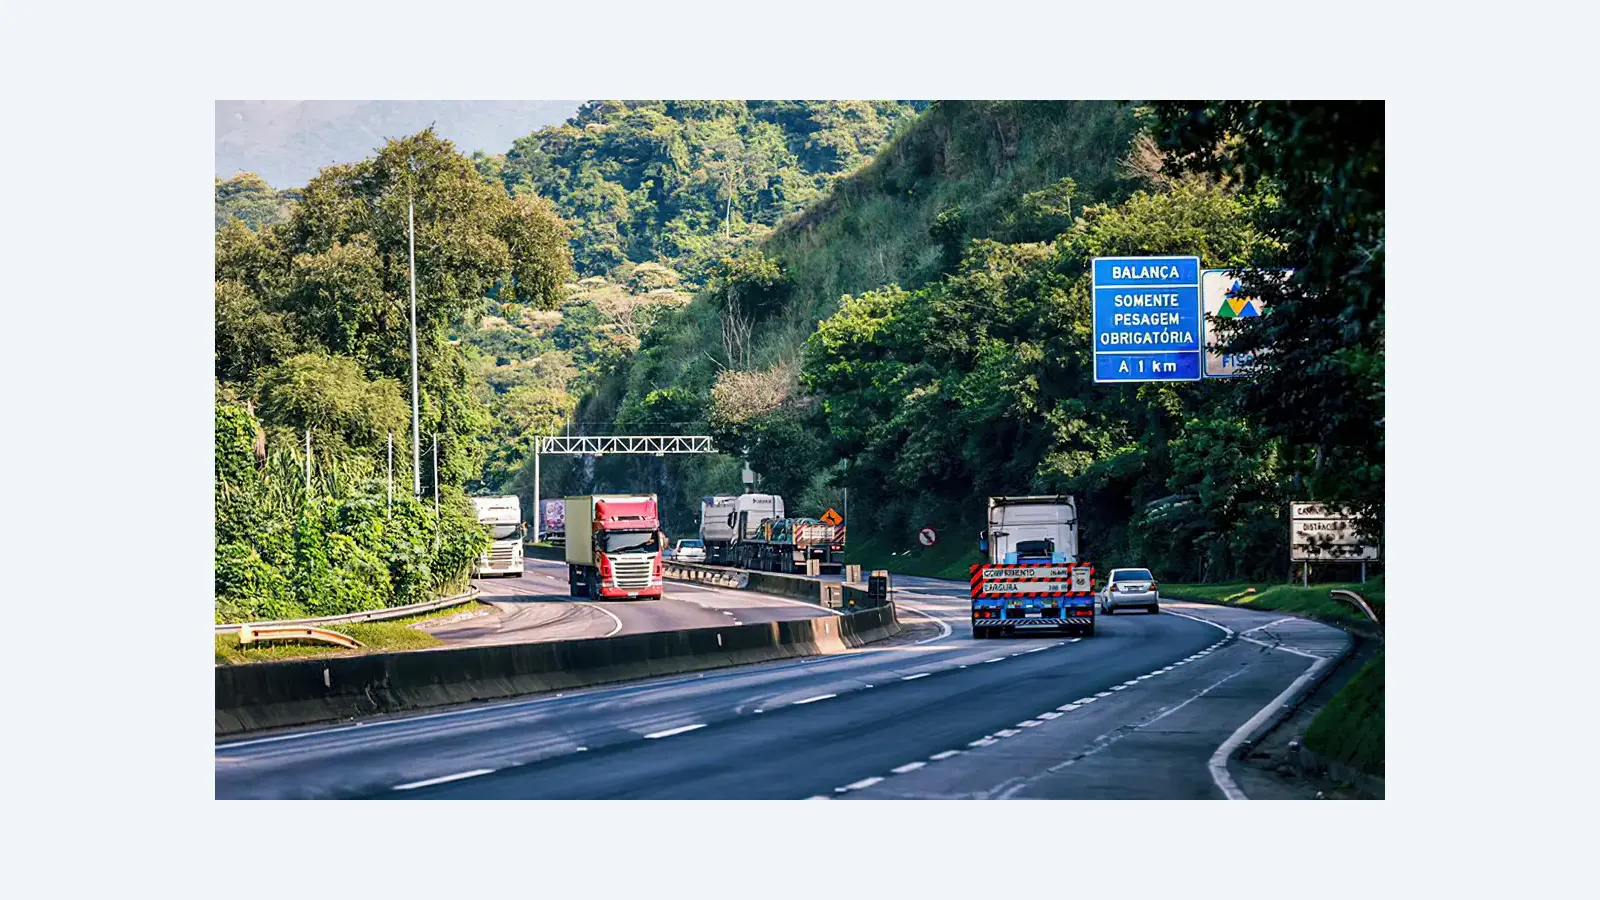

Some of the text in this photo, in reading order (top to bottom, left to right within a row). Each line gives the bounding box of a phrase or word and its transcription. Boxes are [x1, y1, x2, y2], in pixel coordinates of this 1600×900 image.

[1112, 266, 1179, 280] BALANÇA
[1114, 293, 1179, 307] SOMENTE
[1114, 312, 1179, 326] PESAGEM
[1100, 328, 1193, 345] OBRIGATÓRIA
[1118, 360, 1177, 373] A 1 km
